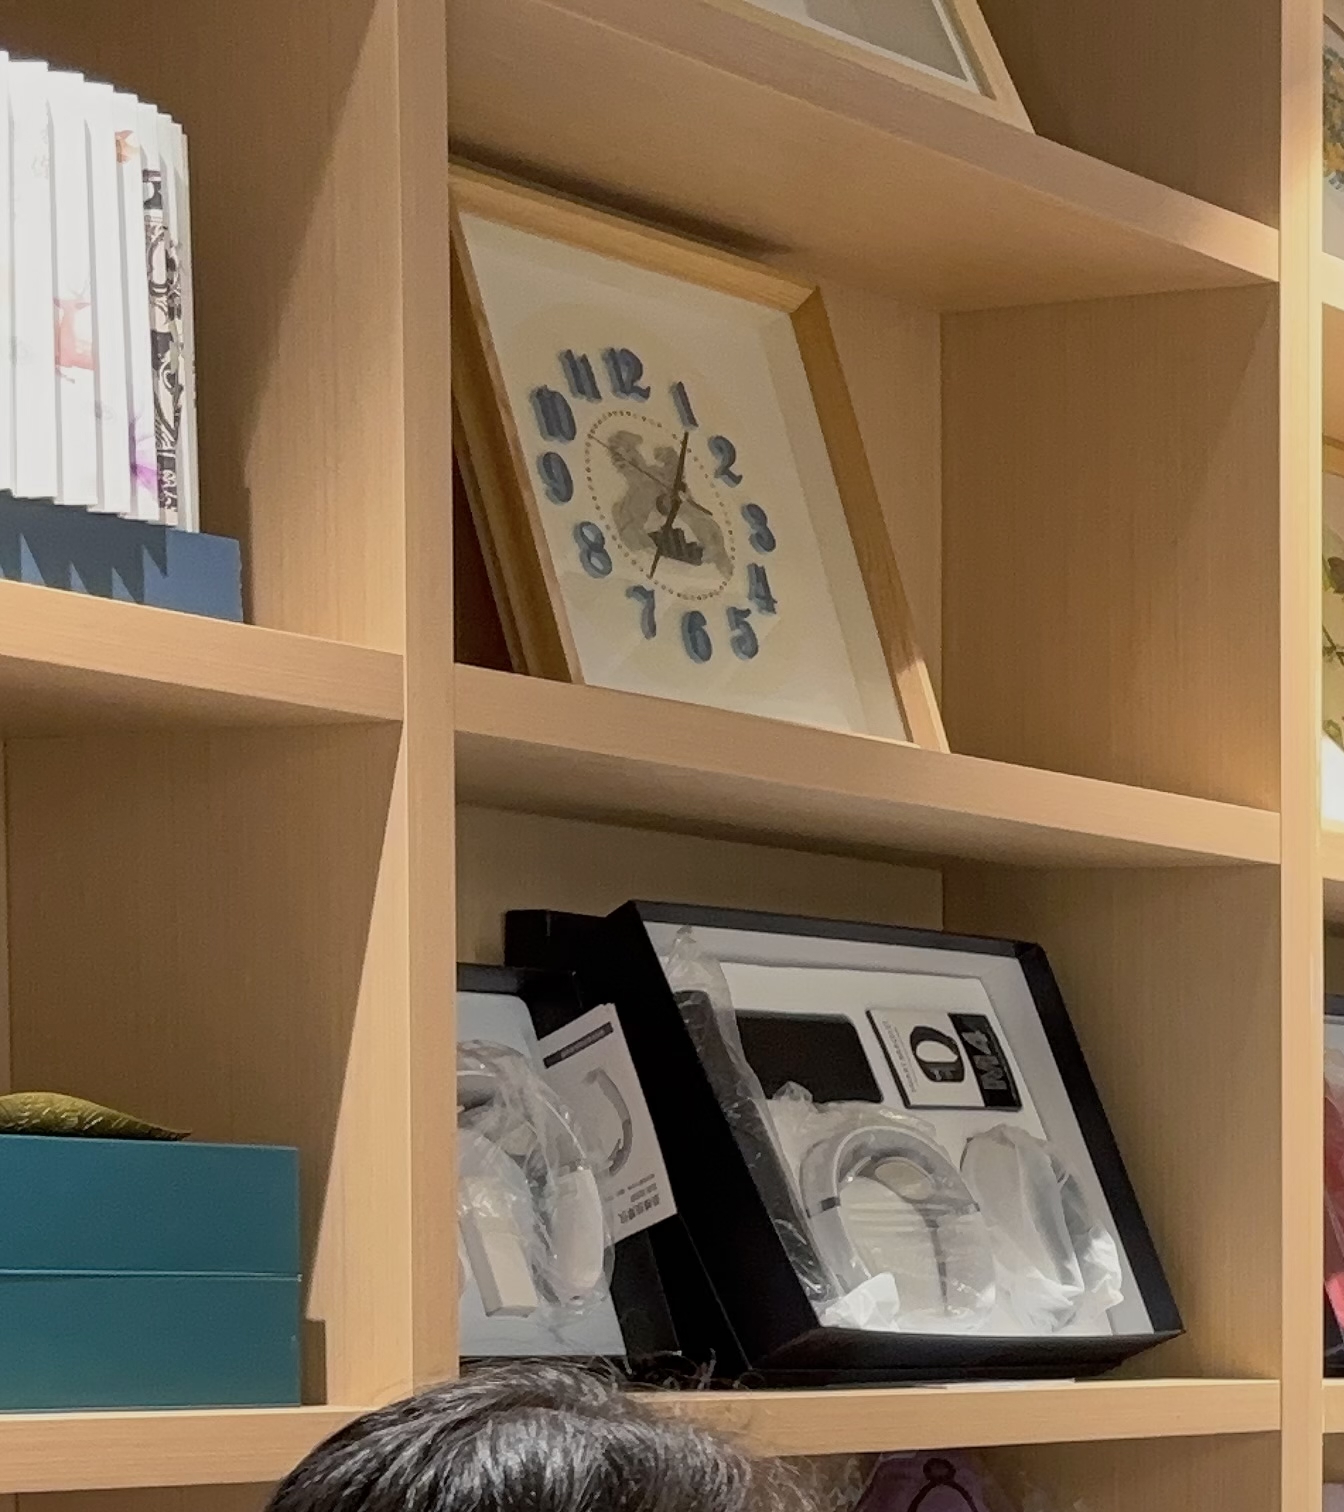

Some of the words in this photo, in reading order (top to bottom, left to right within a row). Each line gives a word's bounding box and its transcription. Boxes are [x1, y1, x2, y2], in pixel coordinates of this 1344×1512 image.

[558, 349, 602, 403] 11
[602, 347, 651, 401] 12
[530, 384, 577, 443] 10
[669, 381, 699, 430] 1
[537, 451, 574, 505] 9
[707, 435, 743, 487] 2
[573, 521, 613, 578] 8
[741, 503, 776, 553] 3
[626, 585, 656, 640] 7
[747, 562, 778, 614] 4
[681, 610, 712, 664] 6
[726, 606, 758, 660] 5
